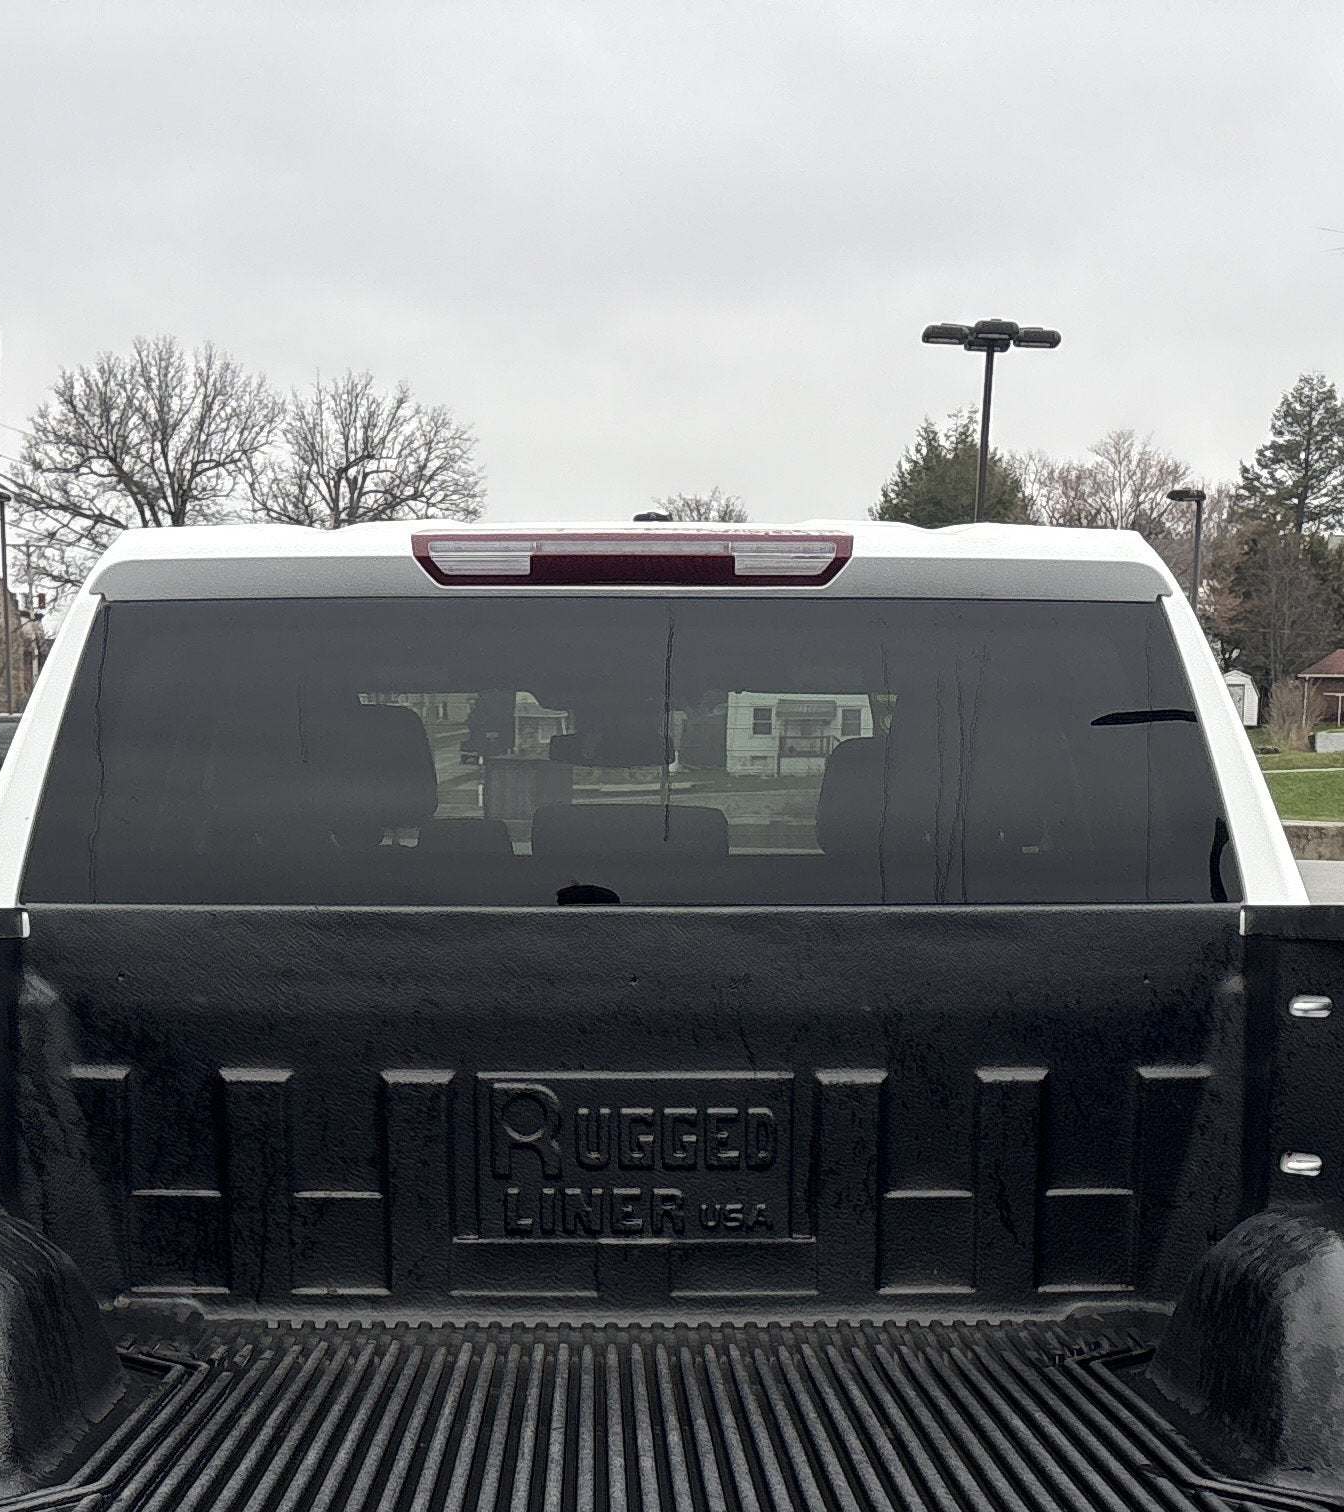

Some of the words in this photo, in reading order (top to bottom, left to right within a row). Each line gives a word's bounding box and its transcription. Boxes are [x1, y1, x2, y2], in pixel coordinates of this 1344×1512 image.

[490, 1082, 777, 1179] RUGGED
[504, 1187, 686, 1236] LINER
[700, 1203, 774, 1231] USA
